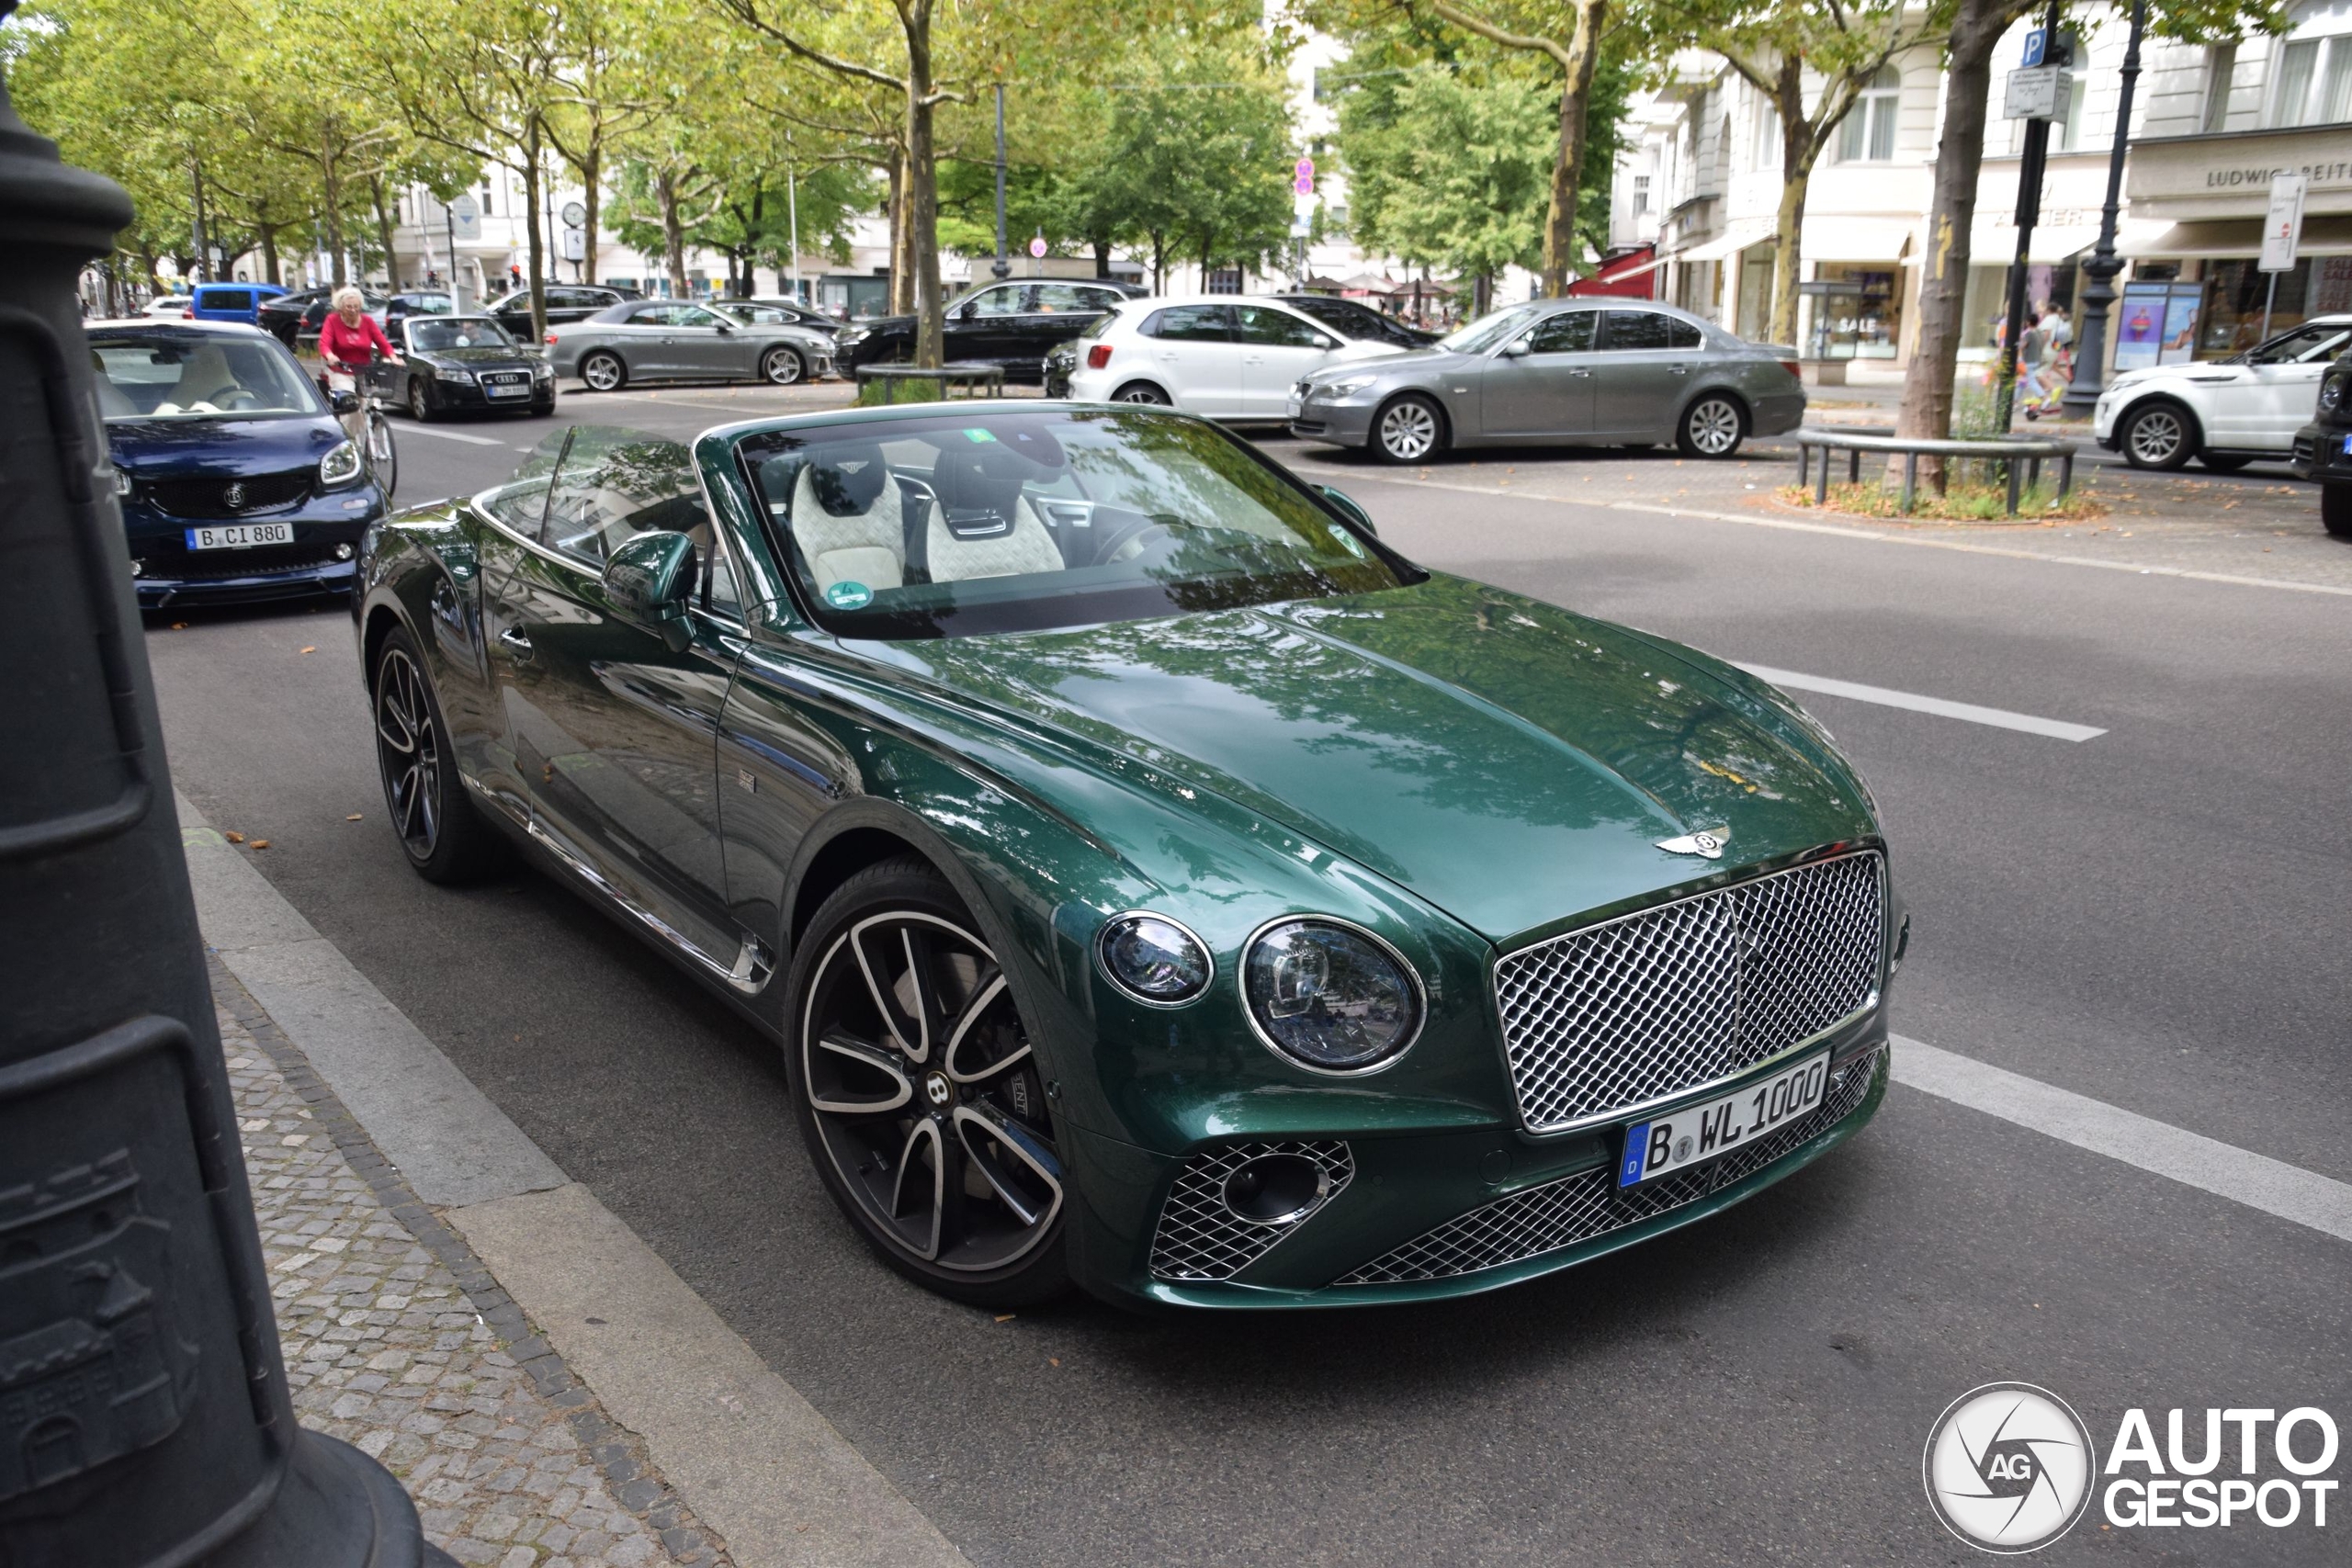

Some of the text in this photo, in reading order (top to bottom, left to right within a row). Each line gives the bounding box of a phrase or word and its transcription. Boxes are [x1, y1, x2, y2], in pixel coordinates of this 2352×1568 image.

[2025, 34, 2041, 63] P
[2301, 163, 2352, 181] REIT
[1838, 317, 1877, 333] SALE
[201, 530, 214, 547] B
[225, 527, 248, 544] CI
[254, 525, 287, 542] 880
[842, 583, 854, 594] 4
[927, 1075, 948, 1104] B
[1627, 1060, 1824, 1175] D B WL 1000
